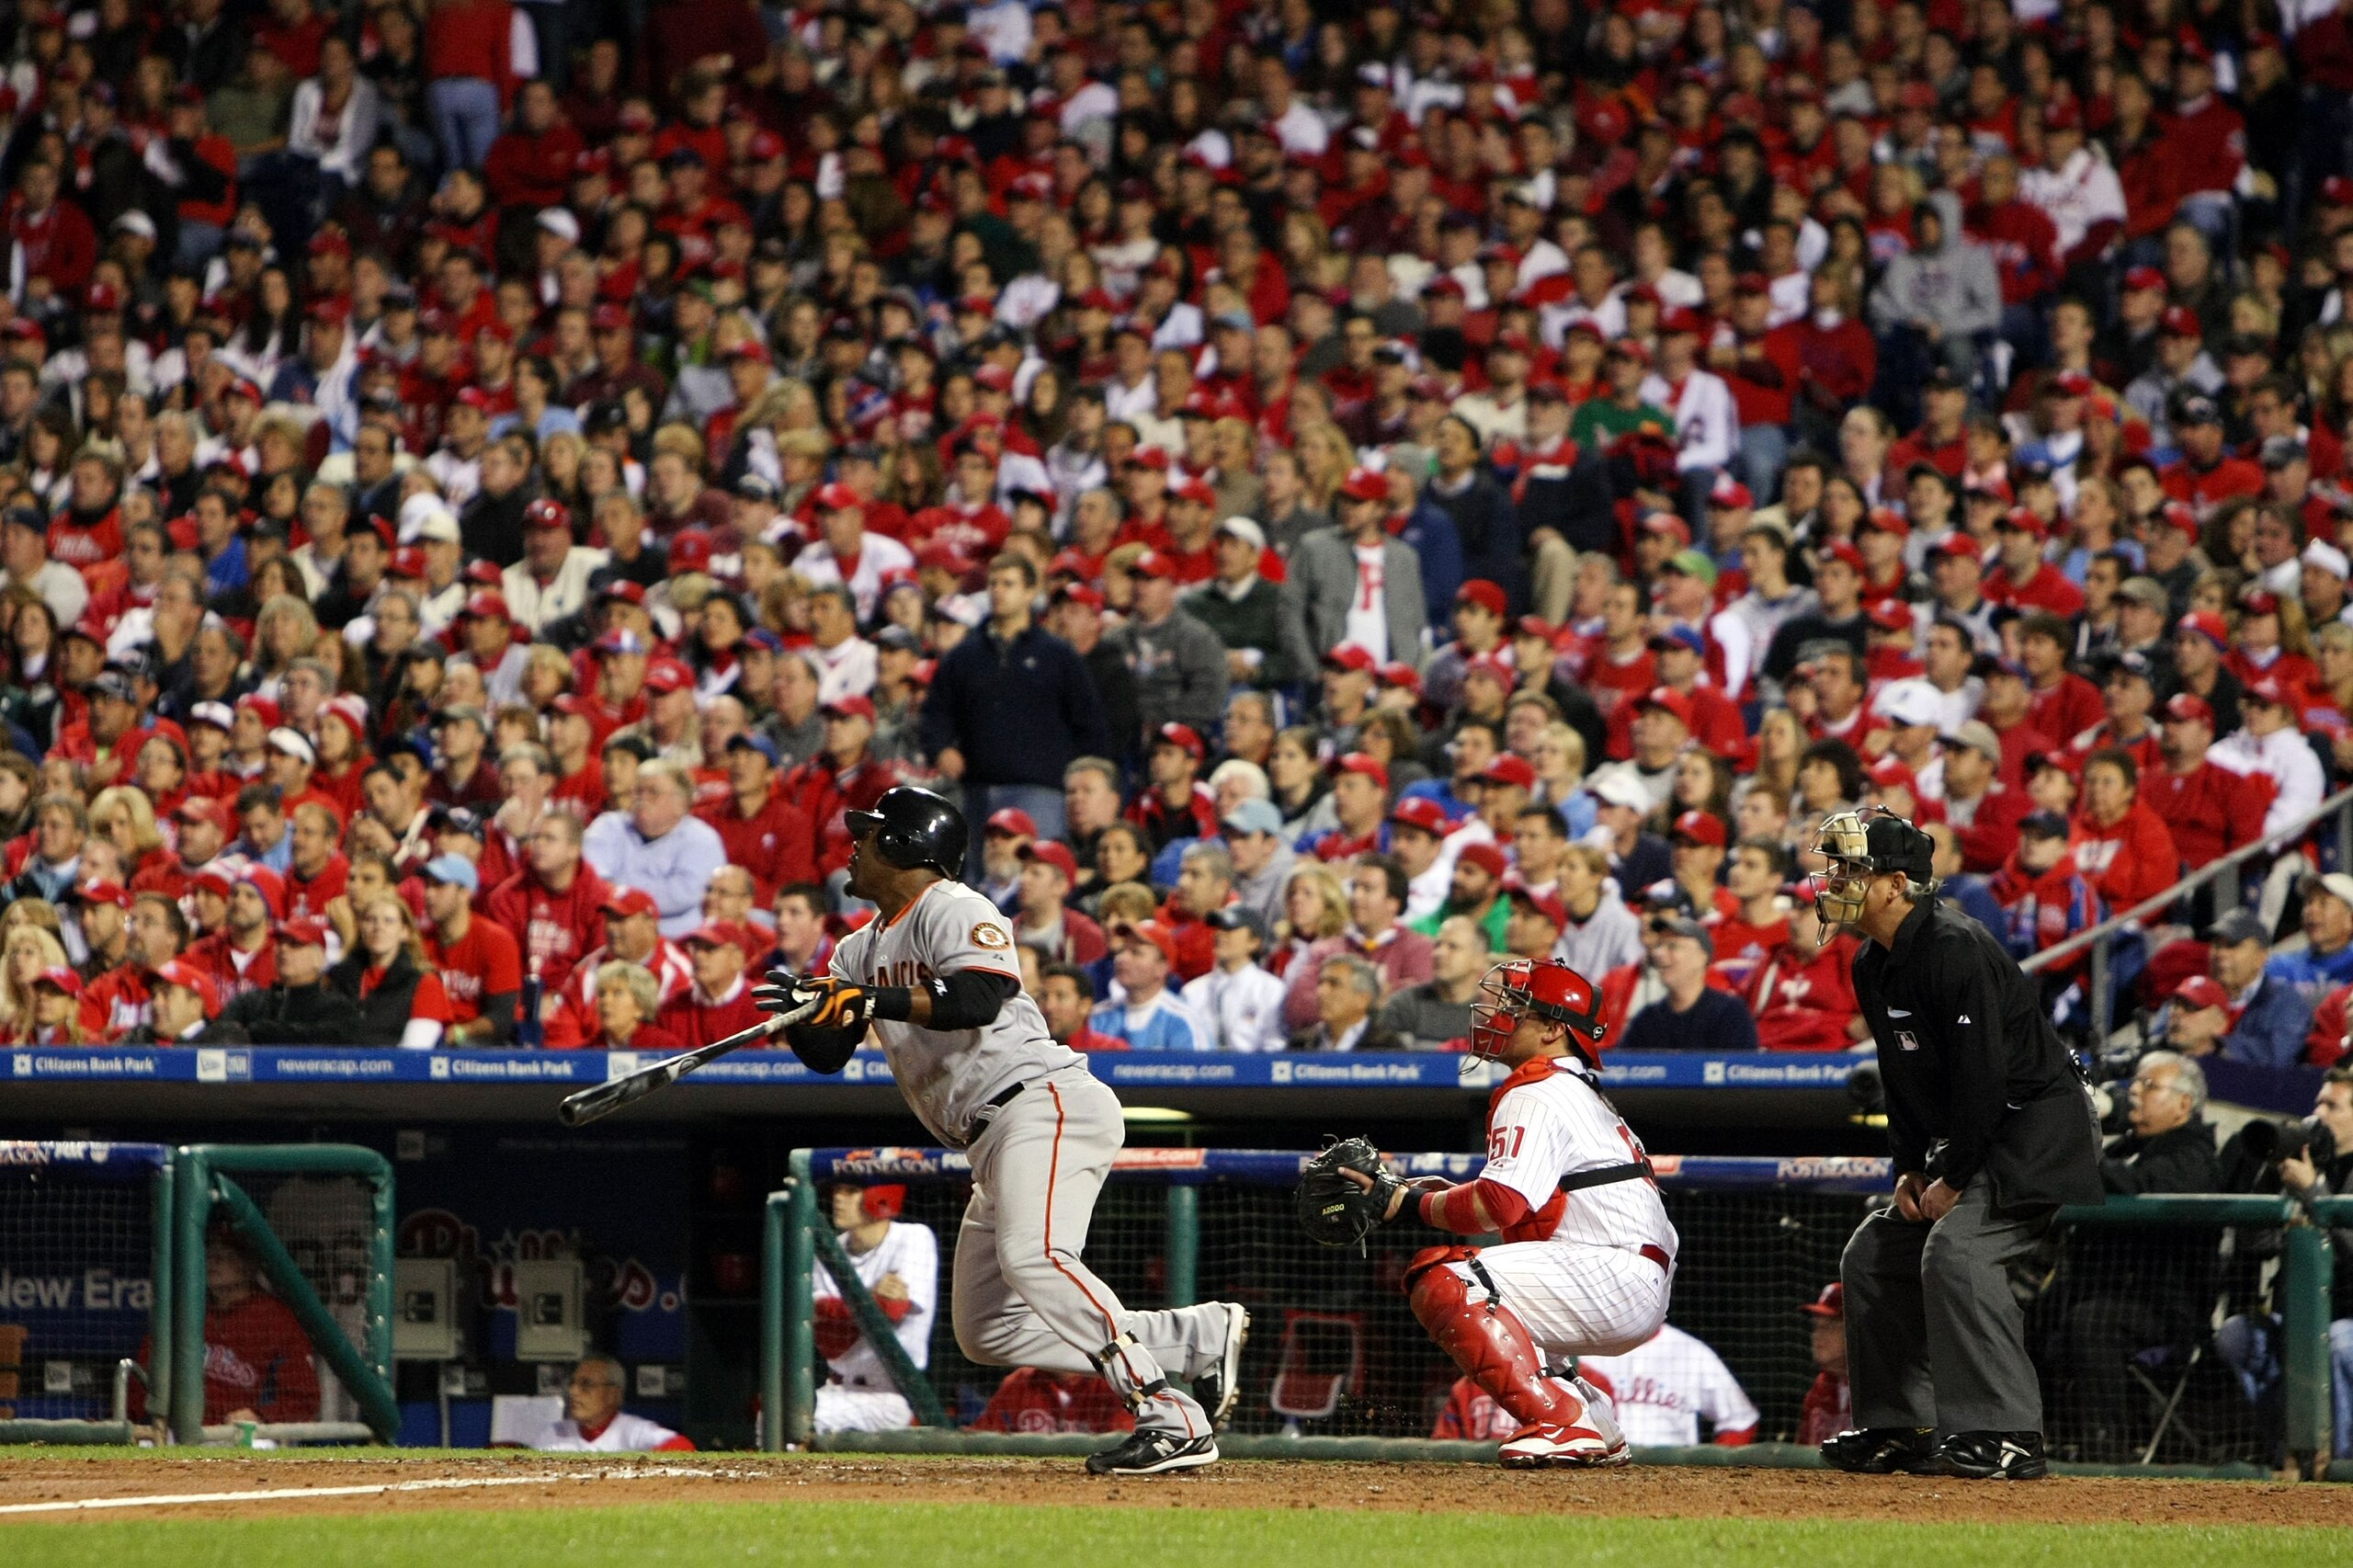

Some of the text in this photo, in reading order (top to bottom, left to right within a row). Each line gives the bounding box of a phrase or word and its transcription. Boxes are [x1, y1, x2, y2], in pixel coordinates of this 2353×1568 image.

[35, 1057, 154, 1074] Citizens Bank Park
[277, 1059, 393, 1075] neweracap.com
[451, 1060, 572, 1076] Citizens Bank Park
[1113, 1063, 1234, 1081] neweracap.com
[1294, 1063, 1419, 1079] Citizens Bank Park
[1727, 1063, 1784, 1080] Citizens
[1786, 1063, 1822, 1080] Bank
[1489, 1126, 1526, 1162] 51
[832, 1158, 938, 1176] POSTSEASON
[1779, 1160, 1890, 1178] POSTSEASON
[84, 1267, 154, 1310] Era
